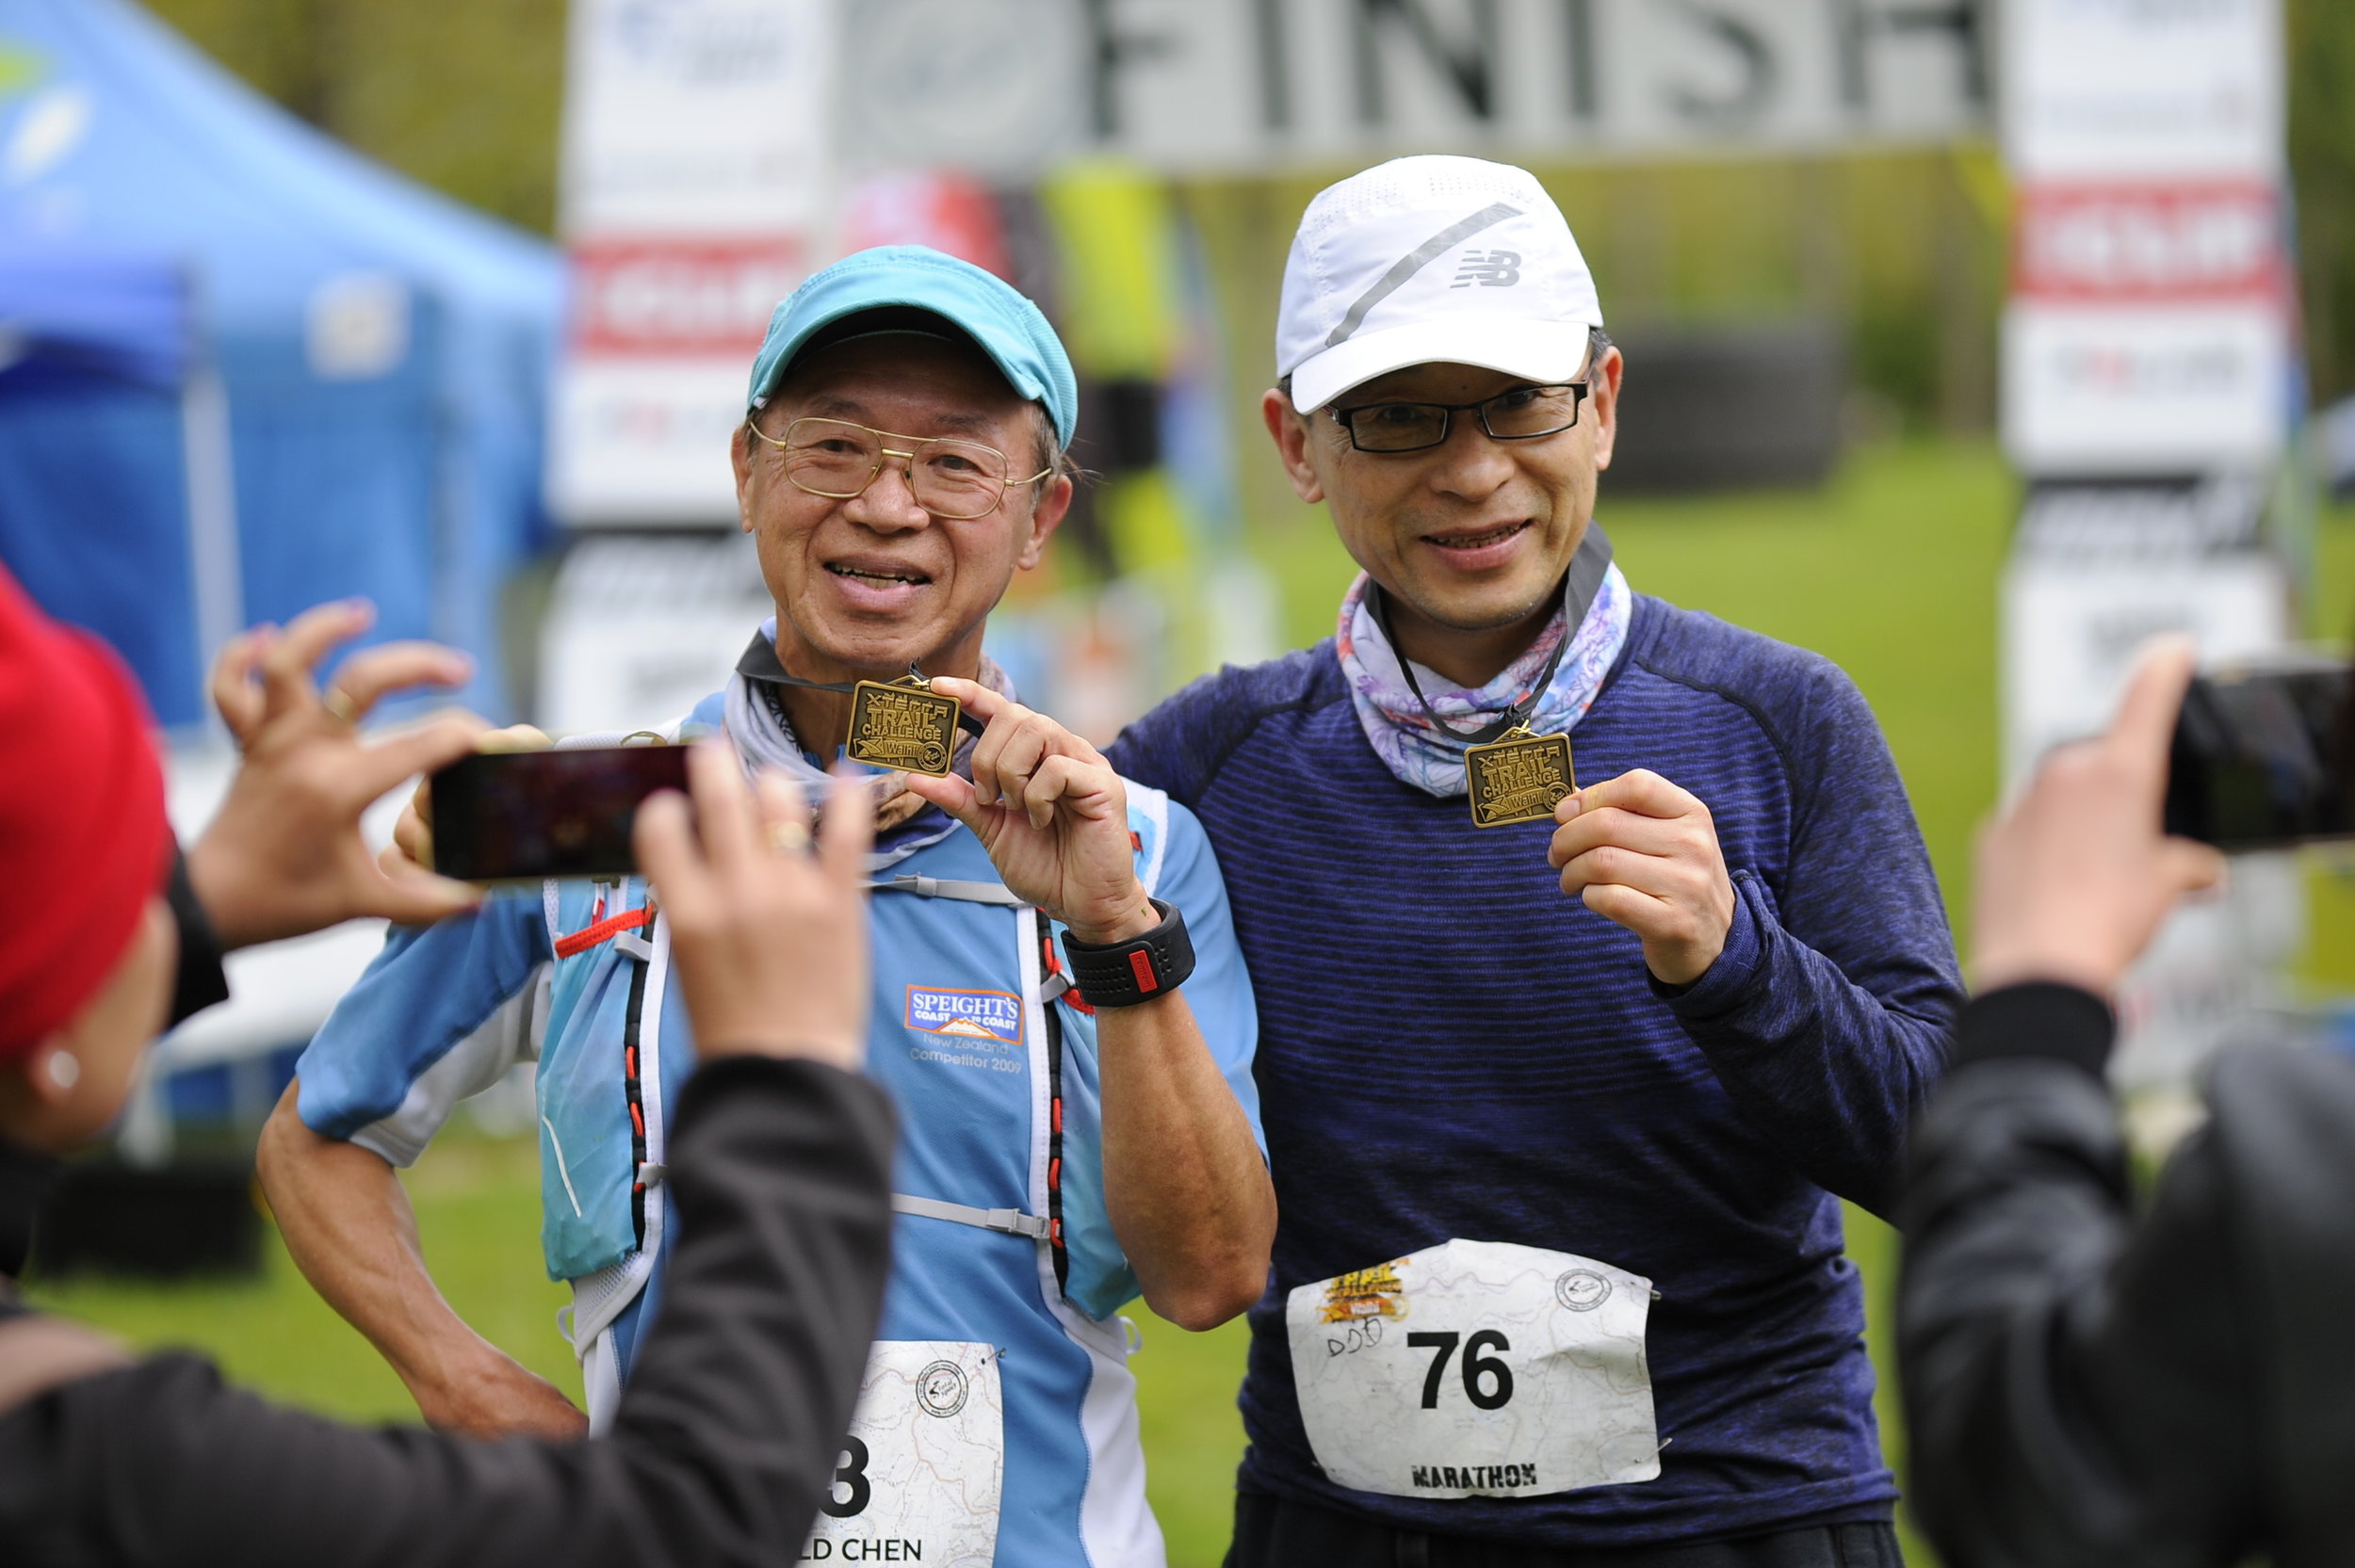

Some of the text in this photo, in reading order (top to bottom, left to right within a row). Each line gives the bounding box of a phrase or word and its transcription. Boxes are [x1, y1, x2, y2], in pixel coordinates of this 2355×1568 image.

[1083, 0, 1992, 137] FINISH
[866, 708, 936, 730] TRAIL
[862, 724, 942, 741] CHALLENGE
[886, 740, 918, 756] Waihi
[1482, 756, 1552, 787] TRAIL
[1483, 768, 1562, 799] CHALLENGE
[1510, 792, 1541, 807] Waihi
[913, 993, 1018, 1020] SPEIGHT'S
[915, 1010, 951, 1023] COAST
[983, 1015, 1016, 1031] COAST
[923, 1033, 1009, 1055] New Zealand
[910, 1047, 1022, 1074] Competitor 2009
[1407, 1329, 1514, 1411] 76
[1412, 1463, 1537, 1489] MARATHON
[842, 1538, 921, 1560] CHEN
